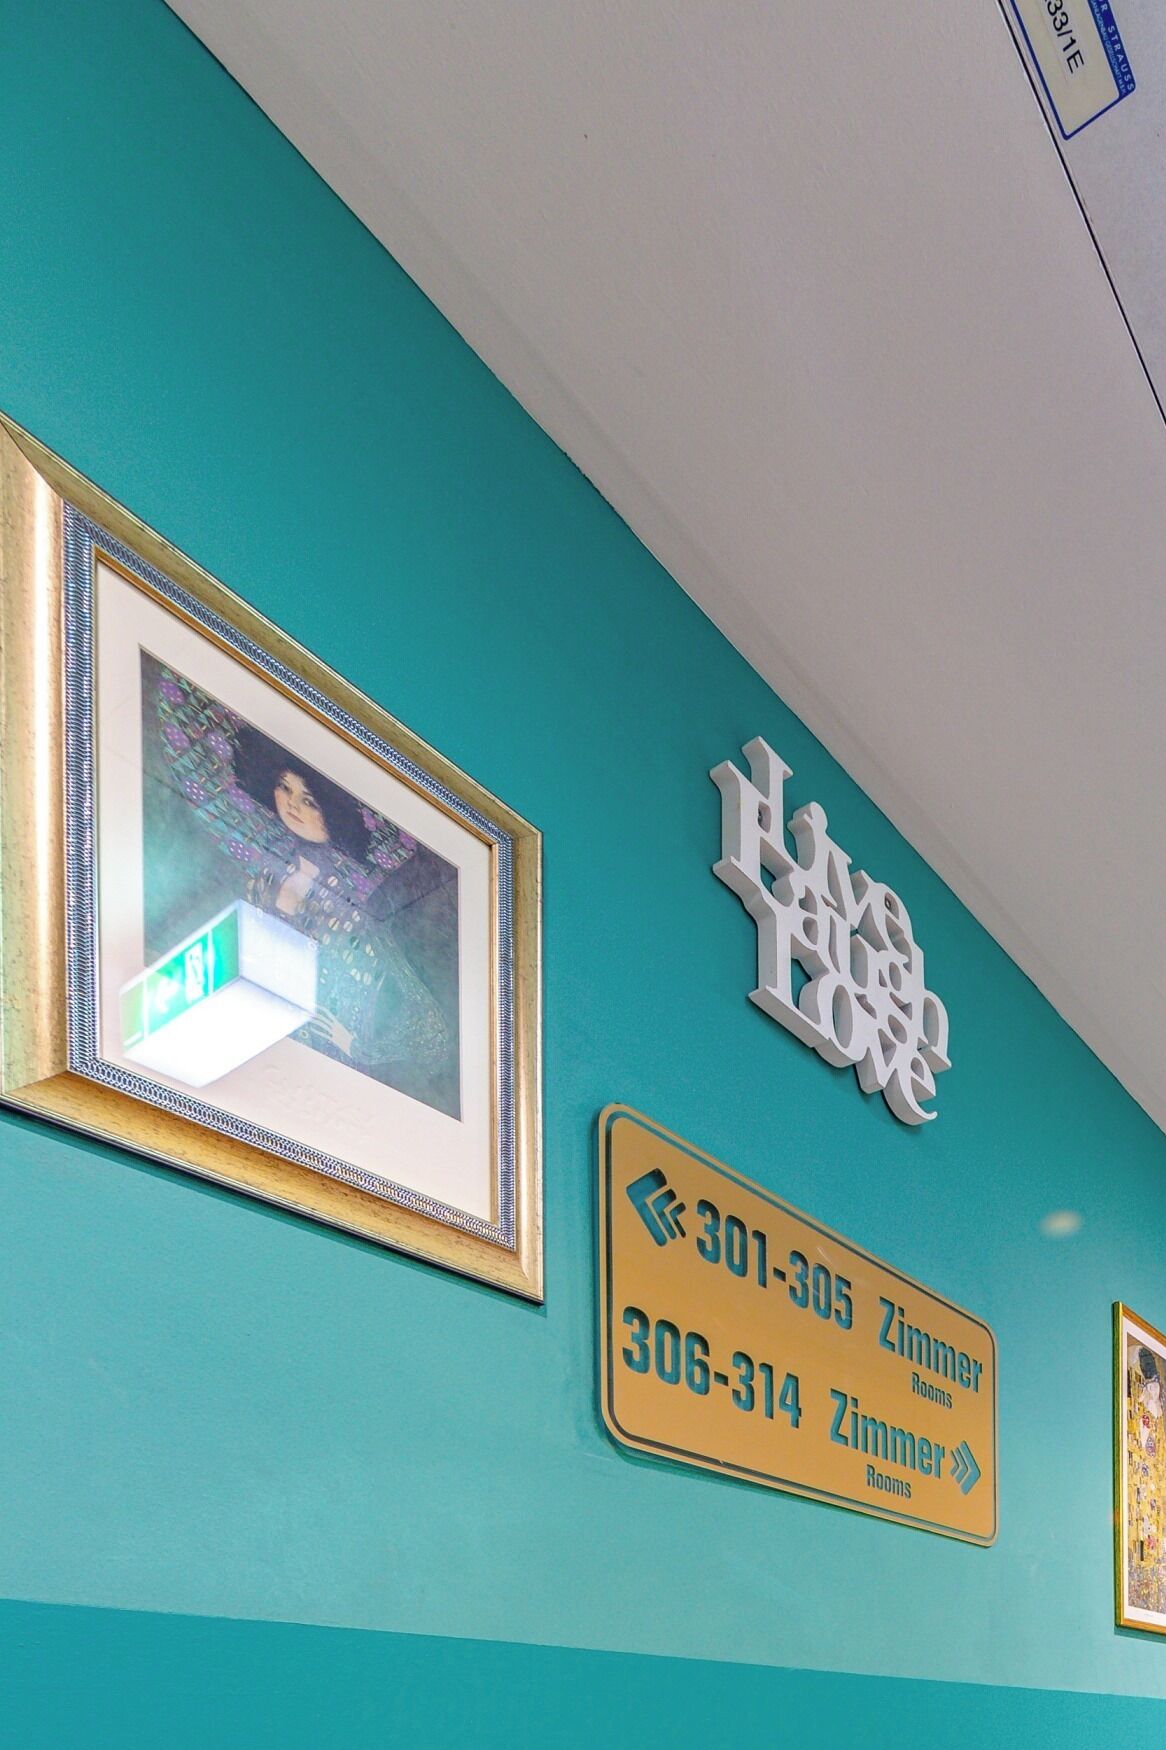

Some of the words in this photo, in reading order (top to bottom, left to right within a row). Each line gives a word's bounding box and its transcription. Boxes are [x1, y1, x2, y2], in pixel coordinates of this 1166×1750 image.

[1045, 0, 1084, 74] 33/1E
[1107, 25, 1135, 91] STRAUSS
[712, 760, 952, 1072] Laugh
[742, 735, 913, 962] Live
[748, 888, 940, 1126] Love
[696, 1199, 853, 1330] 301-305
[879, 1296, 983, 1393] Zimmer
[622, 1306, 802, 1429] 306-314
[830, 1388, 945, 1479] Zimmer
[912, 1372, 952, 1409] Rooms
[866, 1464, 912, 1499] Rooms
